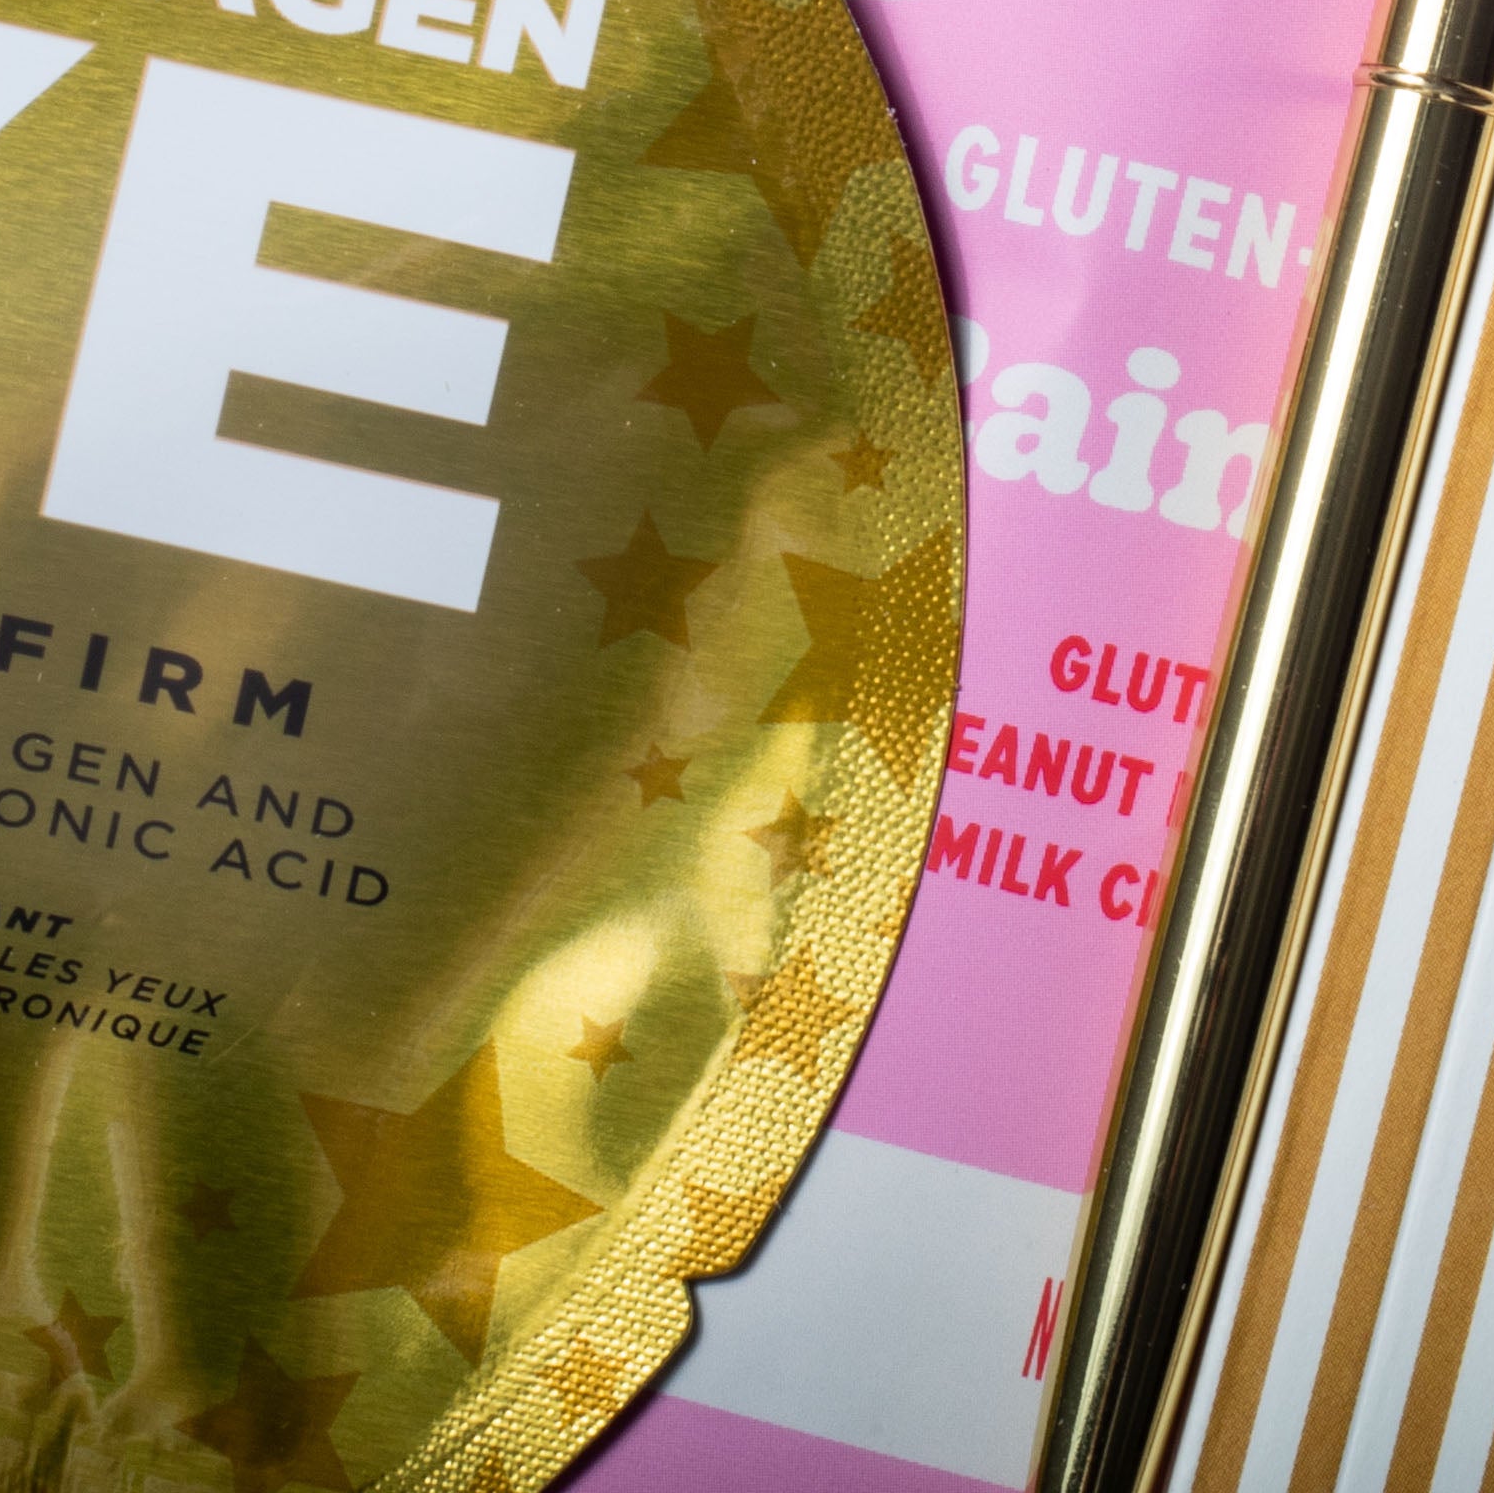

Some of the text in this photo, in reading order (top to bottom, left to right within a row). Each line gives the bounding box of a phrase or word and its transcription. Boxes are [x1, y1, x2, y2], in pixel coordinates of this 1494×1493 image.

[947, 711, 1154, 816] EANUT
[196, 774, 355, 839] AND
[210, 838, 390, 908] ACID
[927, 814, 1083, 908] MILK
[107, 968, 228, 1017] YEUX
